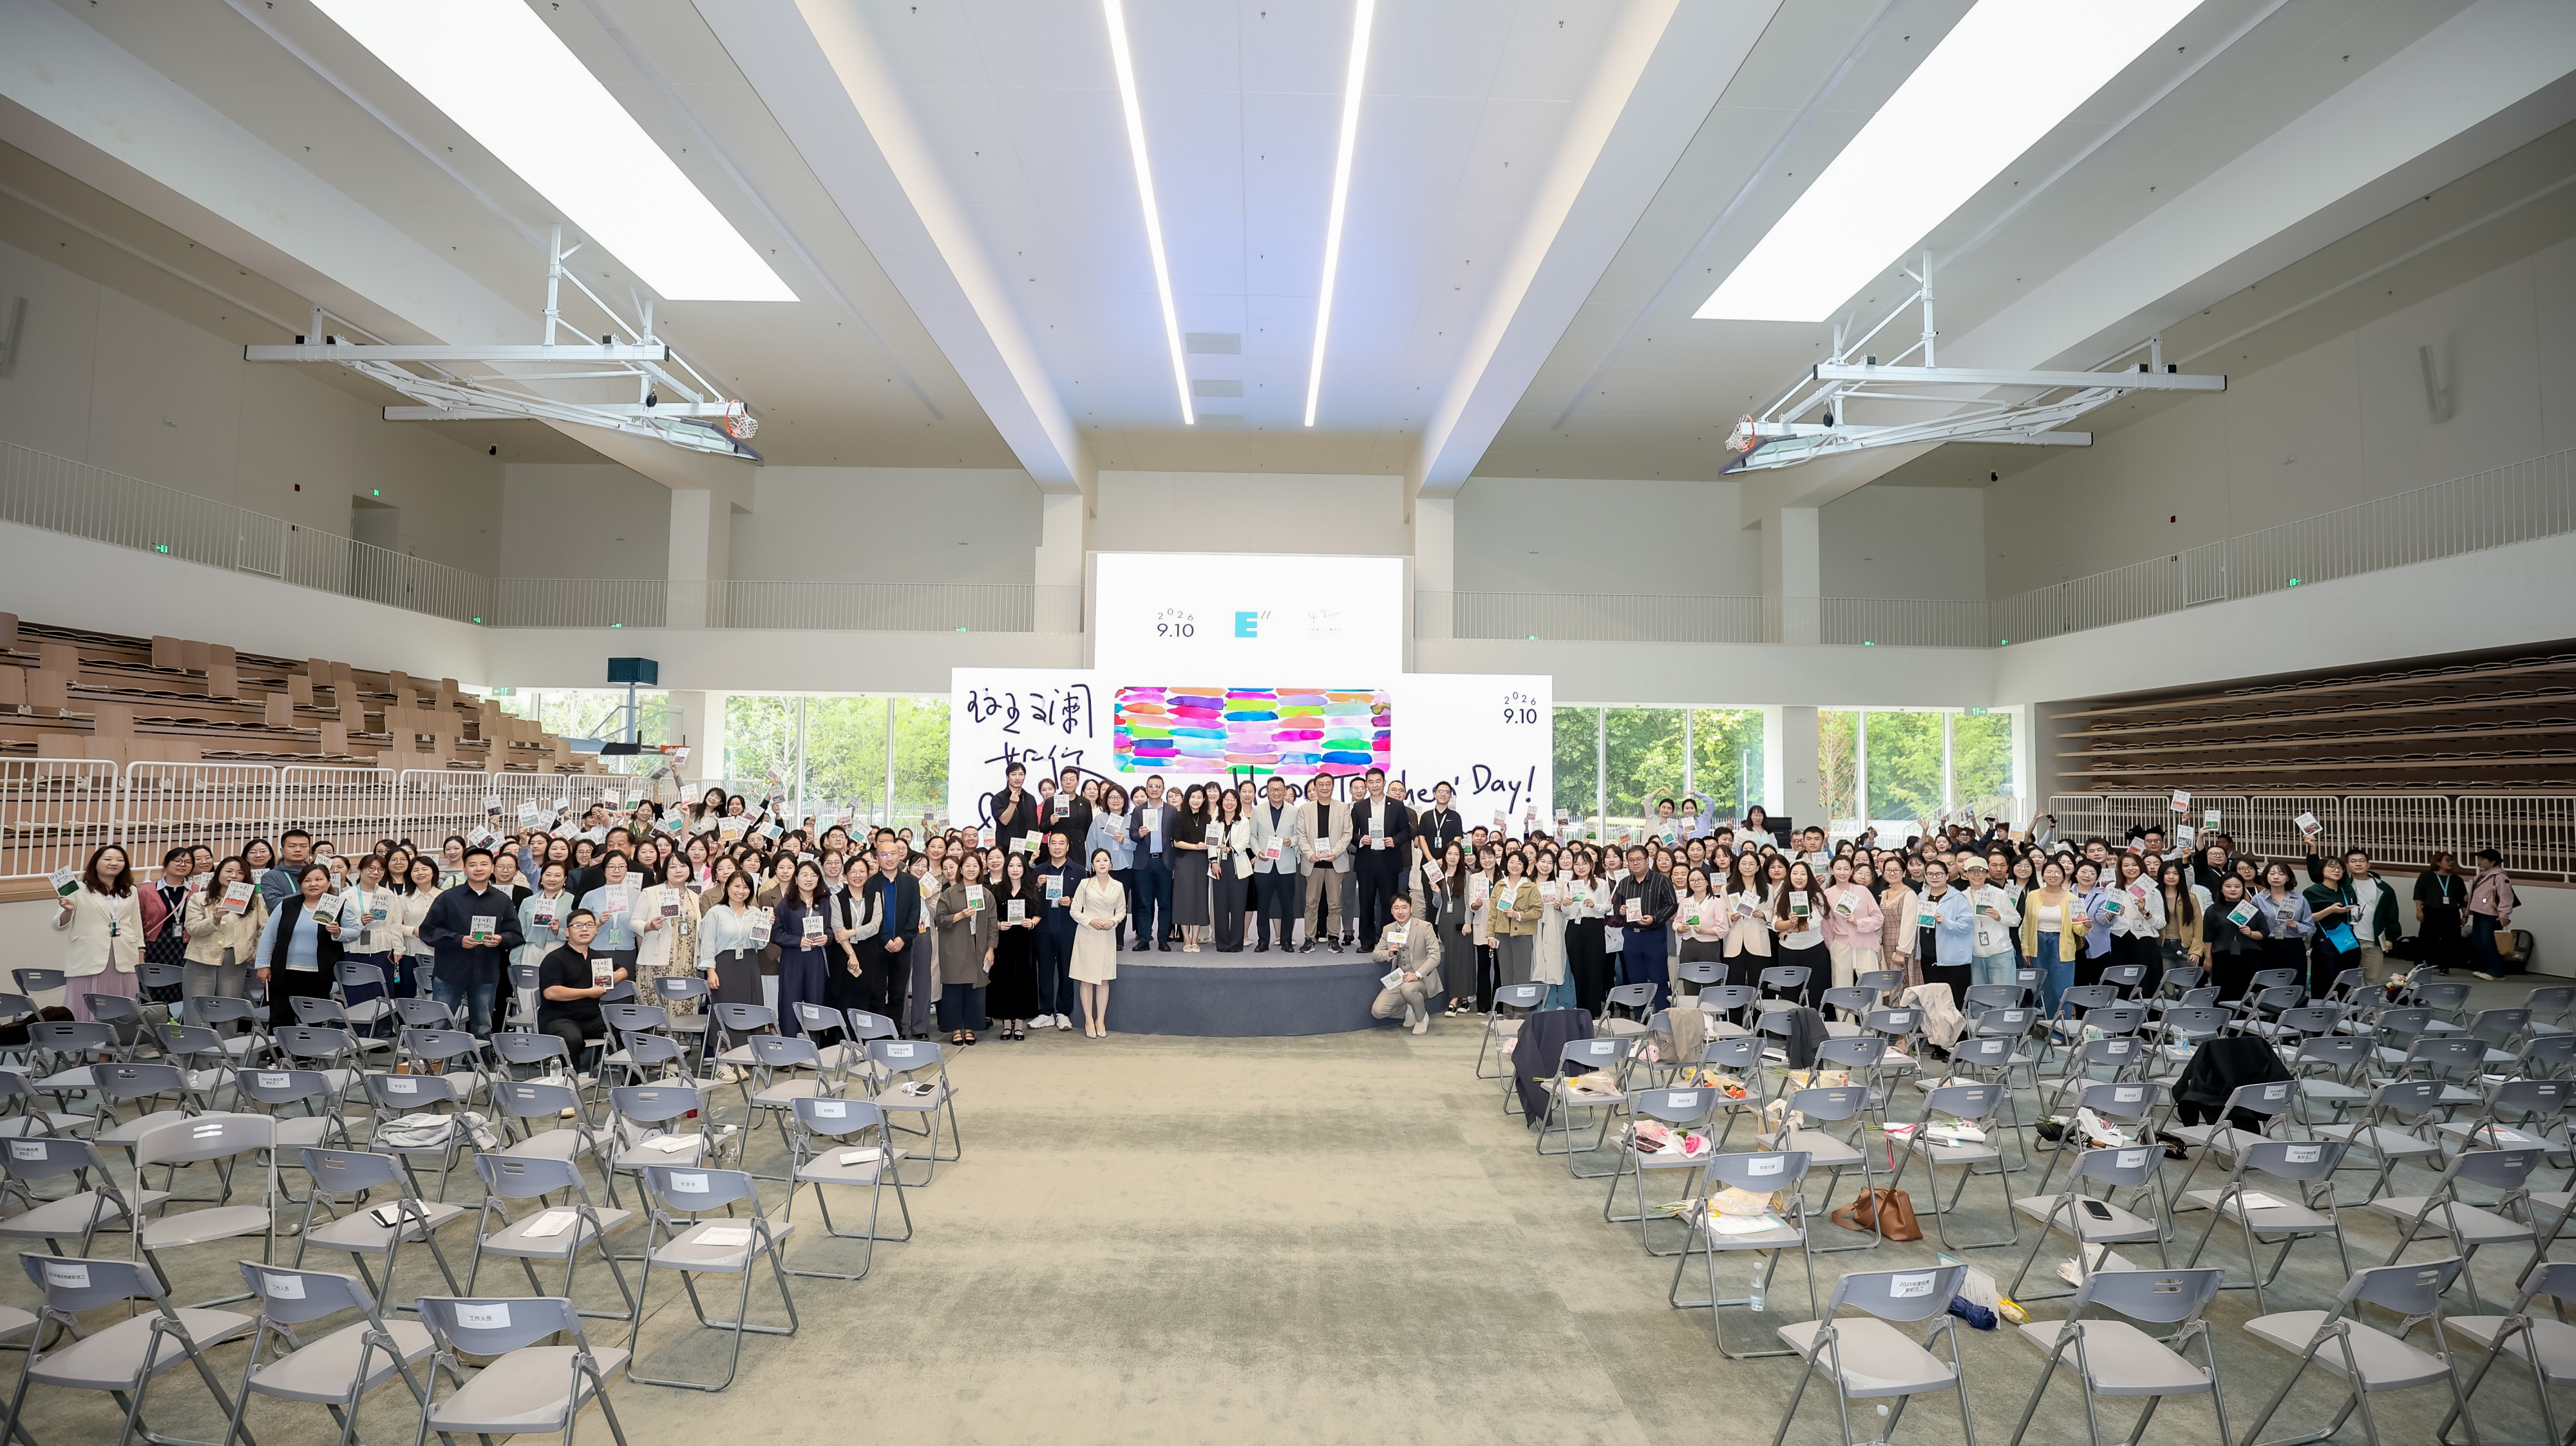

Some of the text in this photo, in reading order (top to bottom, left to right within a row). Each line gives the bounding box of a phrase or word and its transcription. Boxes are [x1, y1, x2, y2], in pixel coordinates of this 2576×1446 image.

[1157, 608, 1193, 621] 2026
[1157, 623, 1194, 638] 9.10
[1504, 691, 1537, 706] 2026
[1504, 708, 1537, 724] 9.10
[1472, 764, 1535, 815] Day!
